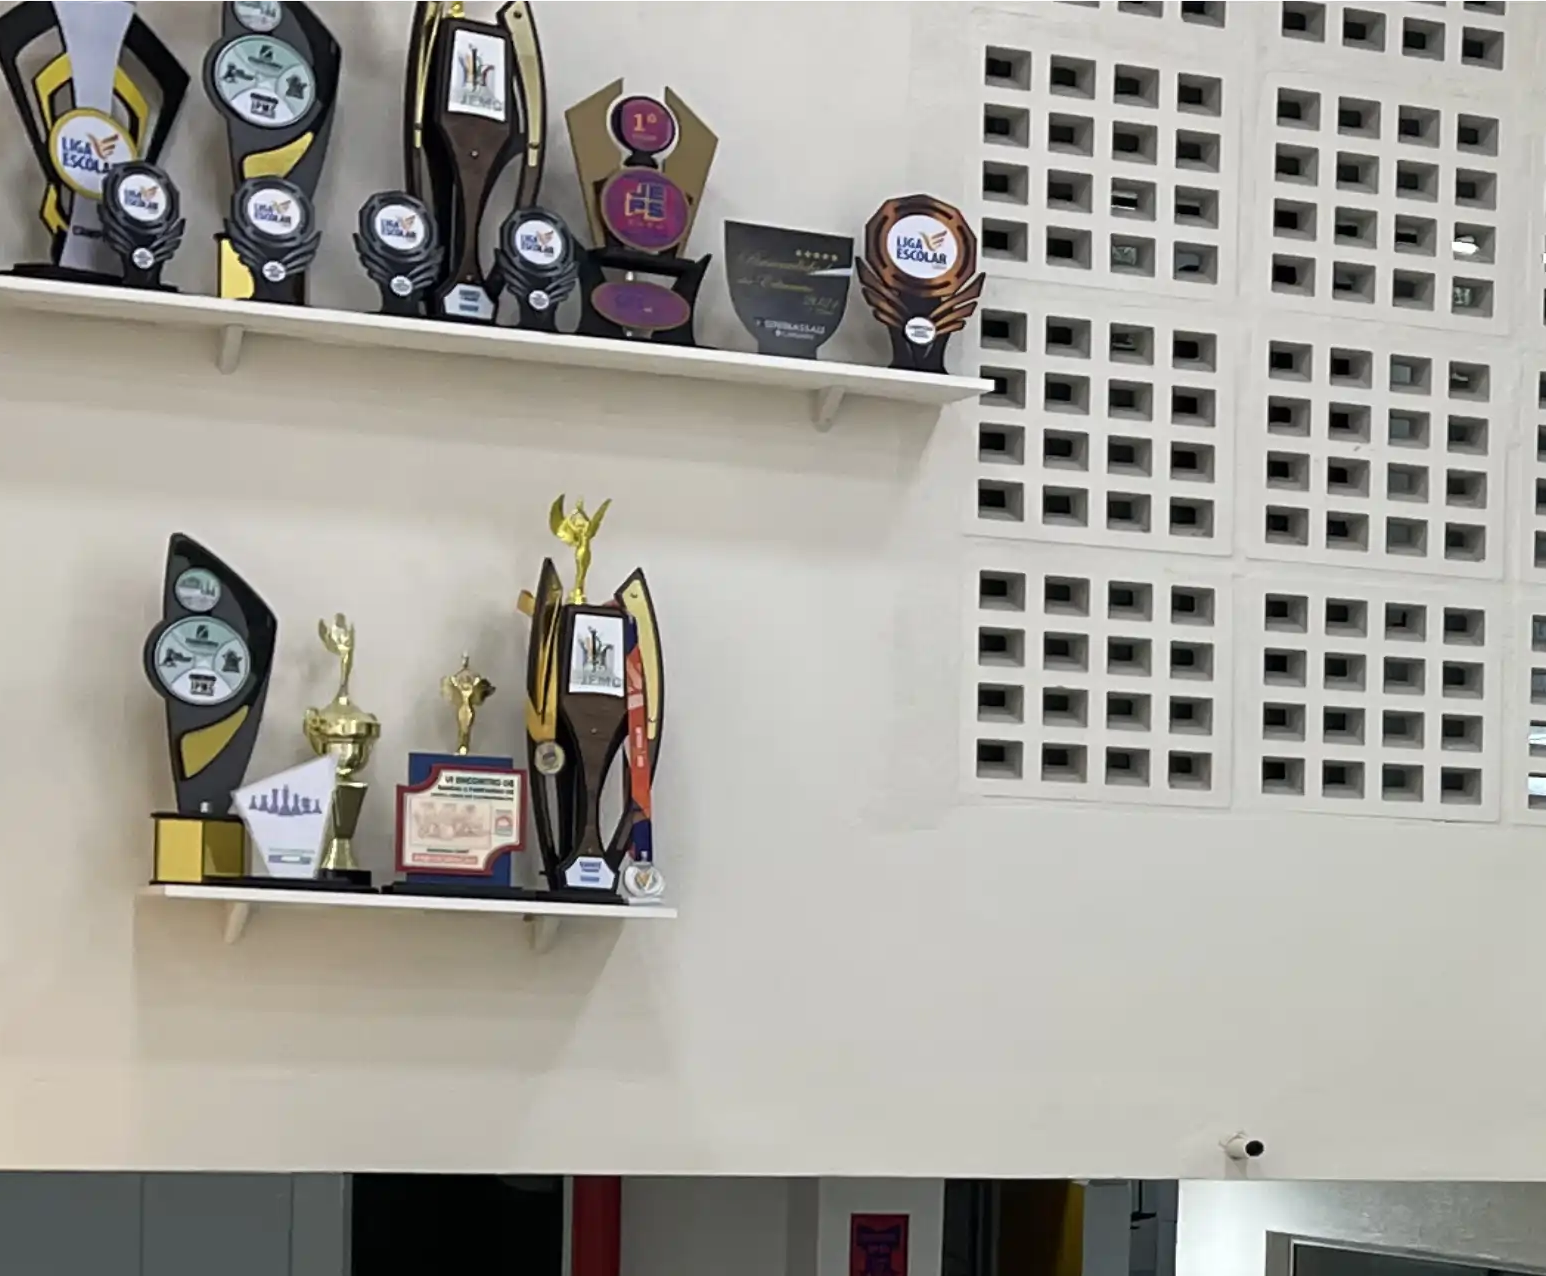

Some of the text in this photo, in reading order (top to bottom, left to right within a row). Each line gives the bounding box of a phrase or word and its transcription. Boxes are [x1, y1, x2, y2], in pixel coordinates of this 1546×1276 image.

[61, 136, 90, 153] LIGA
[61, 153, 114, 174] ESCOLA
[896, 237, 923, 250] LIGA
[896, 248, 947, 265] ESCOLAR
